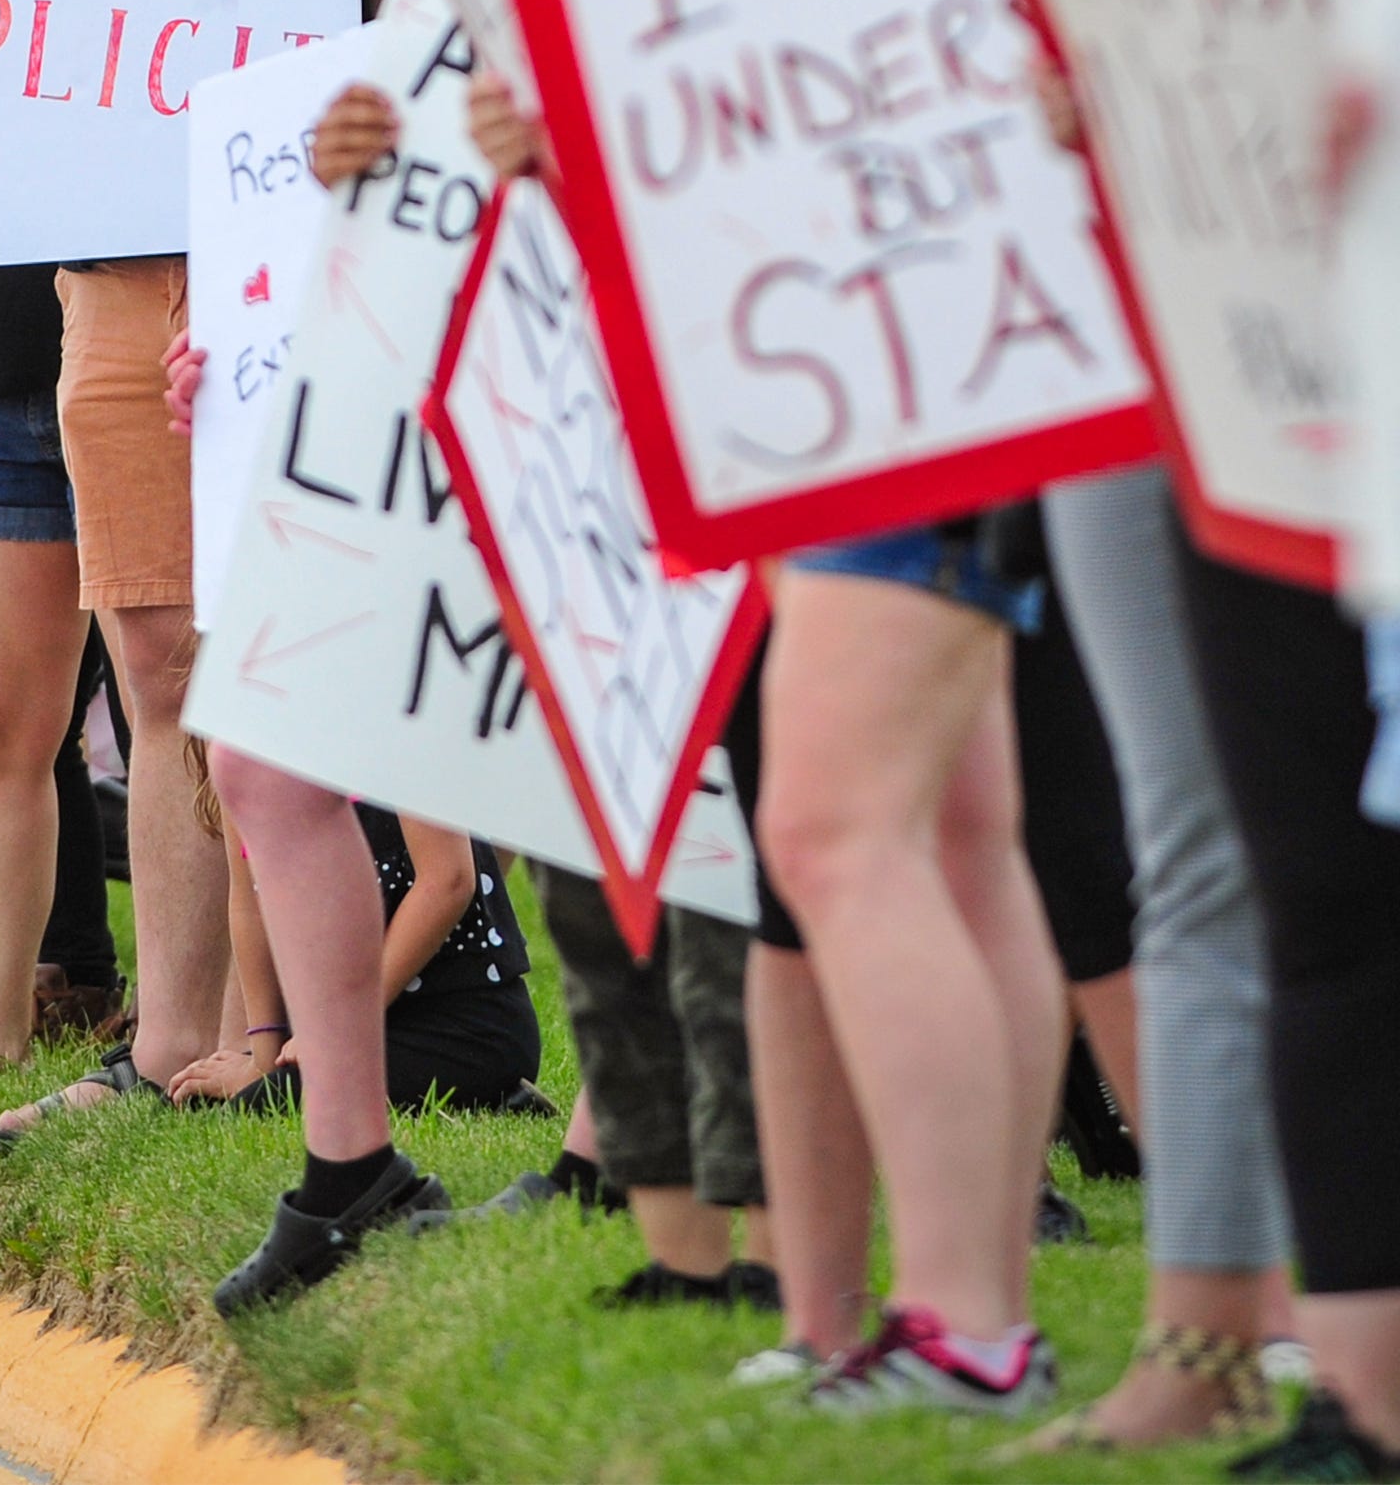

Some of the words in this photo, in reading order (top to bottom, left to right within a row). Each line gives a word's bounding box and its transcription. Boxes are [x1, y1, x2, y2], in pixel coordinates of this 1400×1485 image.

[347, 147, 484, 242] PEO
[826, 115, 1015, 237] BUT
[720, 235, 1100, 469] STA
[283, 383, 457, 524] LIV
